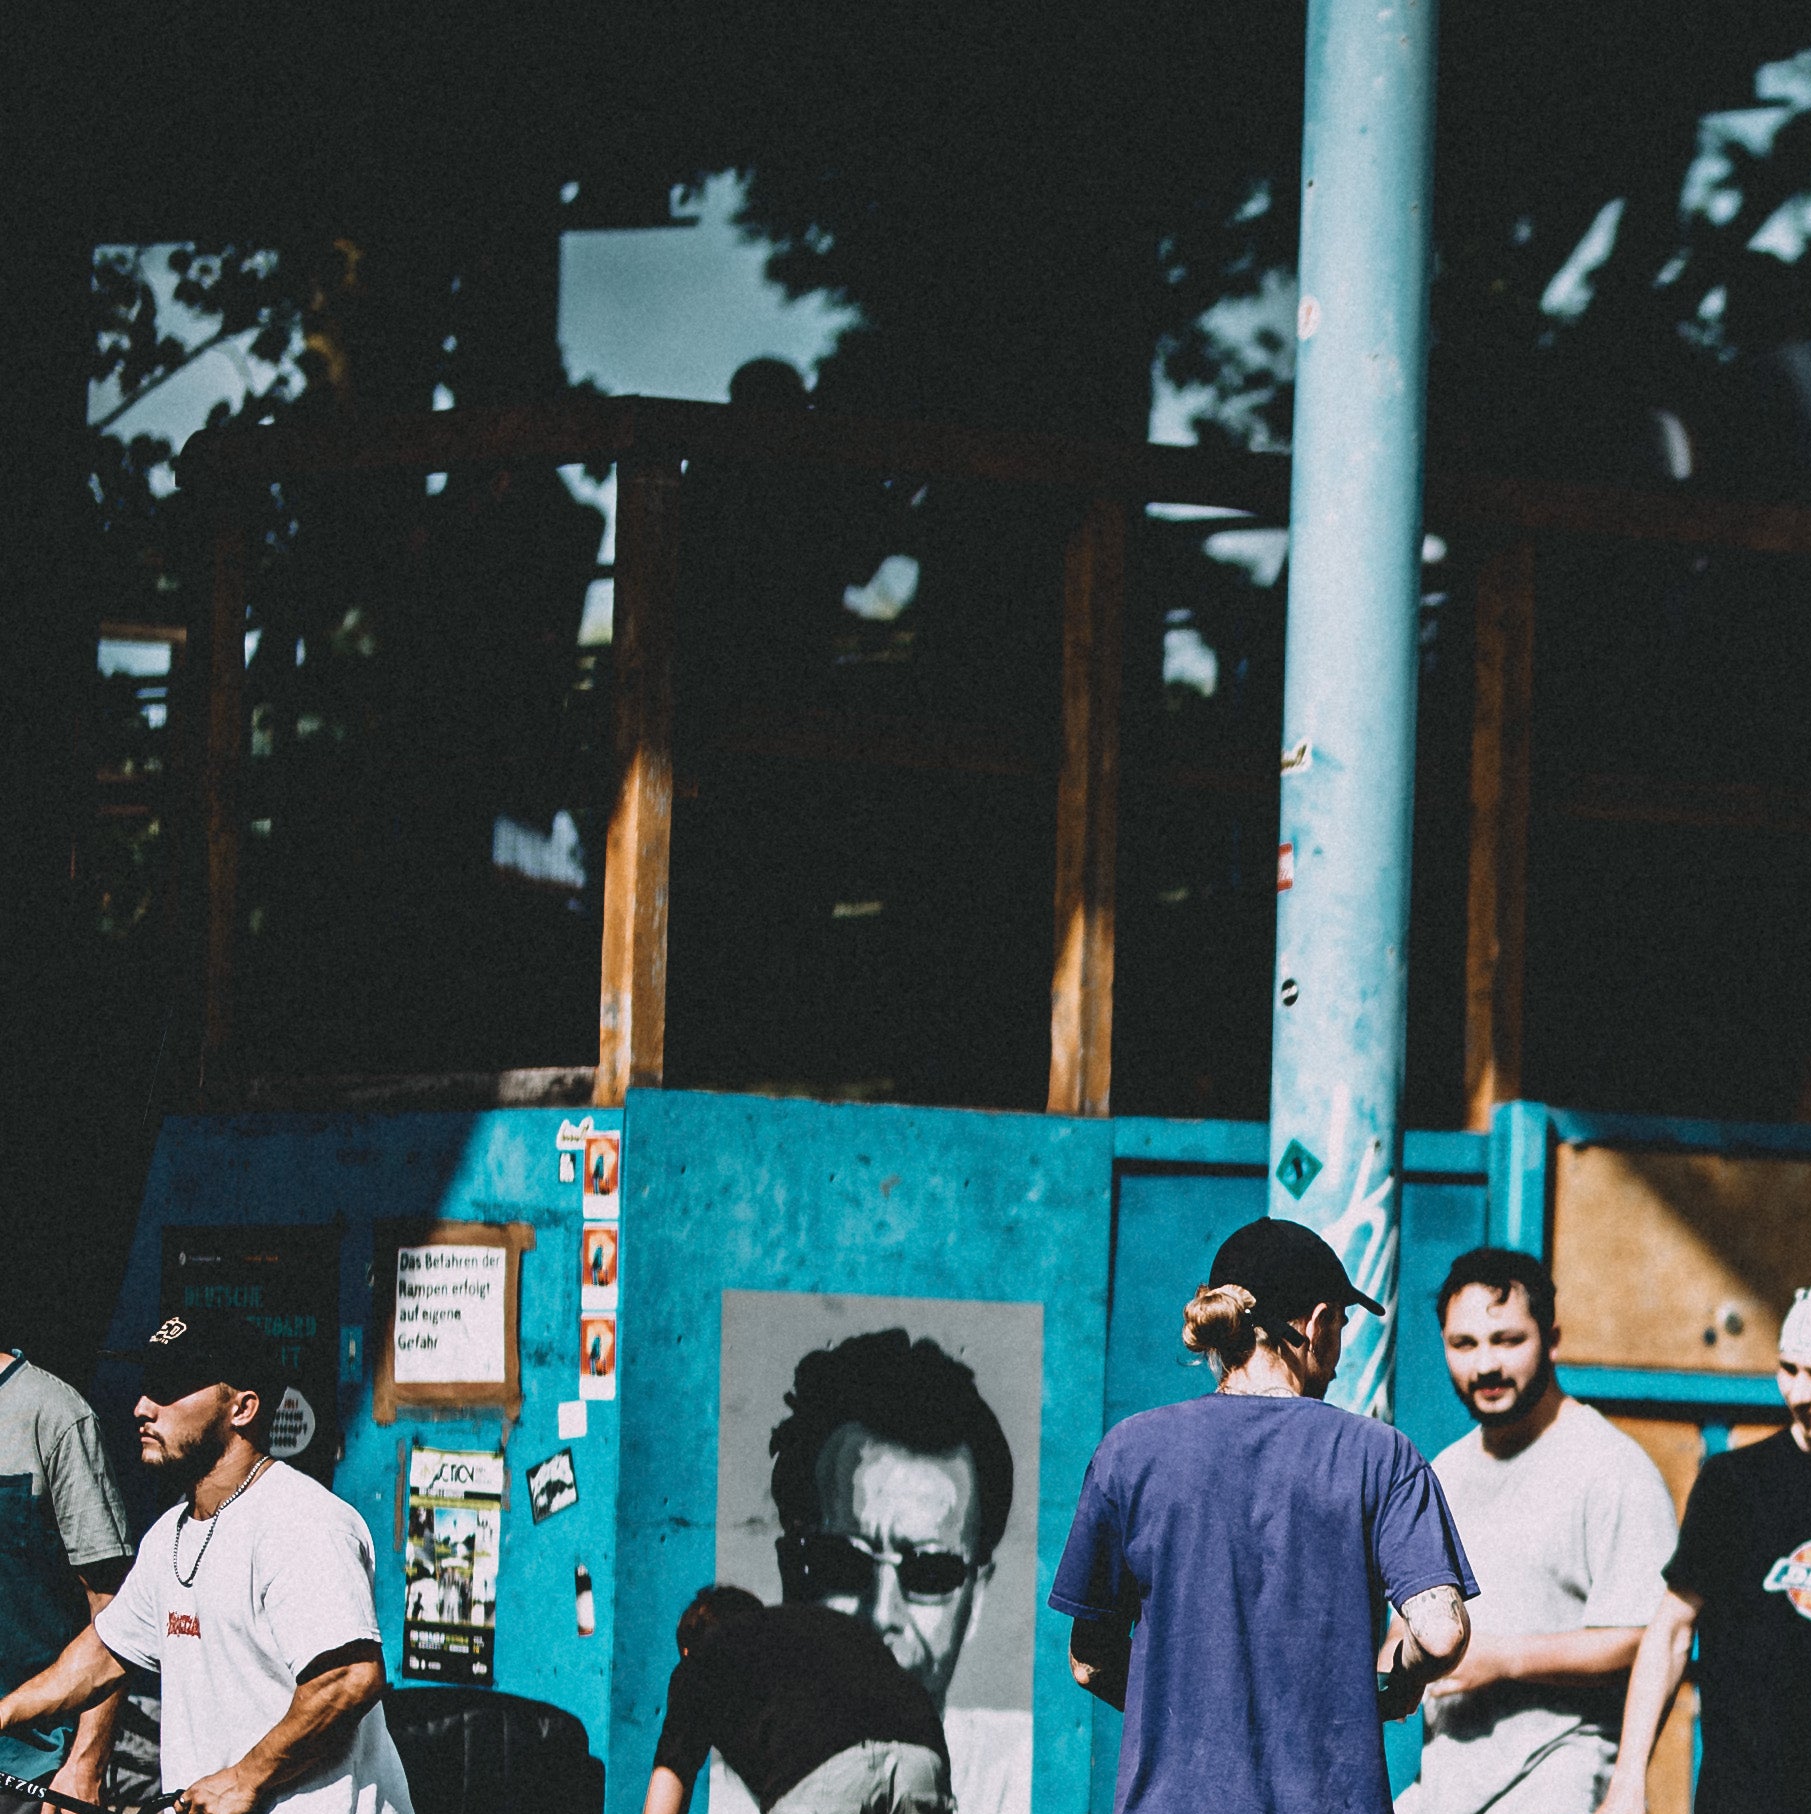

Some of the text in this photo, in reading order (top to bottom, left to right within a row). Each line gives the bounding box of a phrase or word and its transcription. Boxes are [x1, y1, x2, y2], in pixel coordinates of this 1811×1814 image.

[400, 1252, 500, 1271] Das Befahren der
[398, 1278, 490, 1299] Rampen erfolgt
[400, 1304, 461, 1324] auf eigene
[398, 1333, 438, 1351] Gefahr
